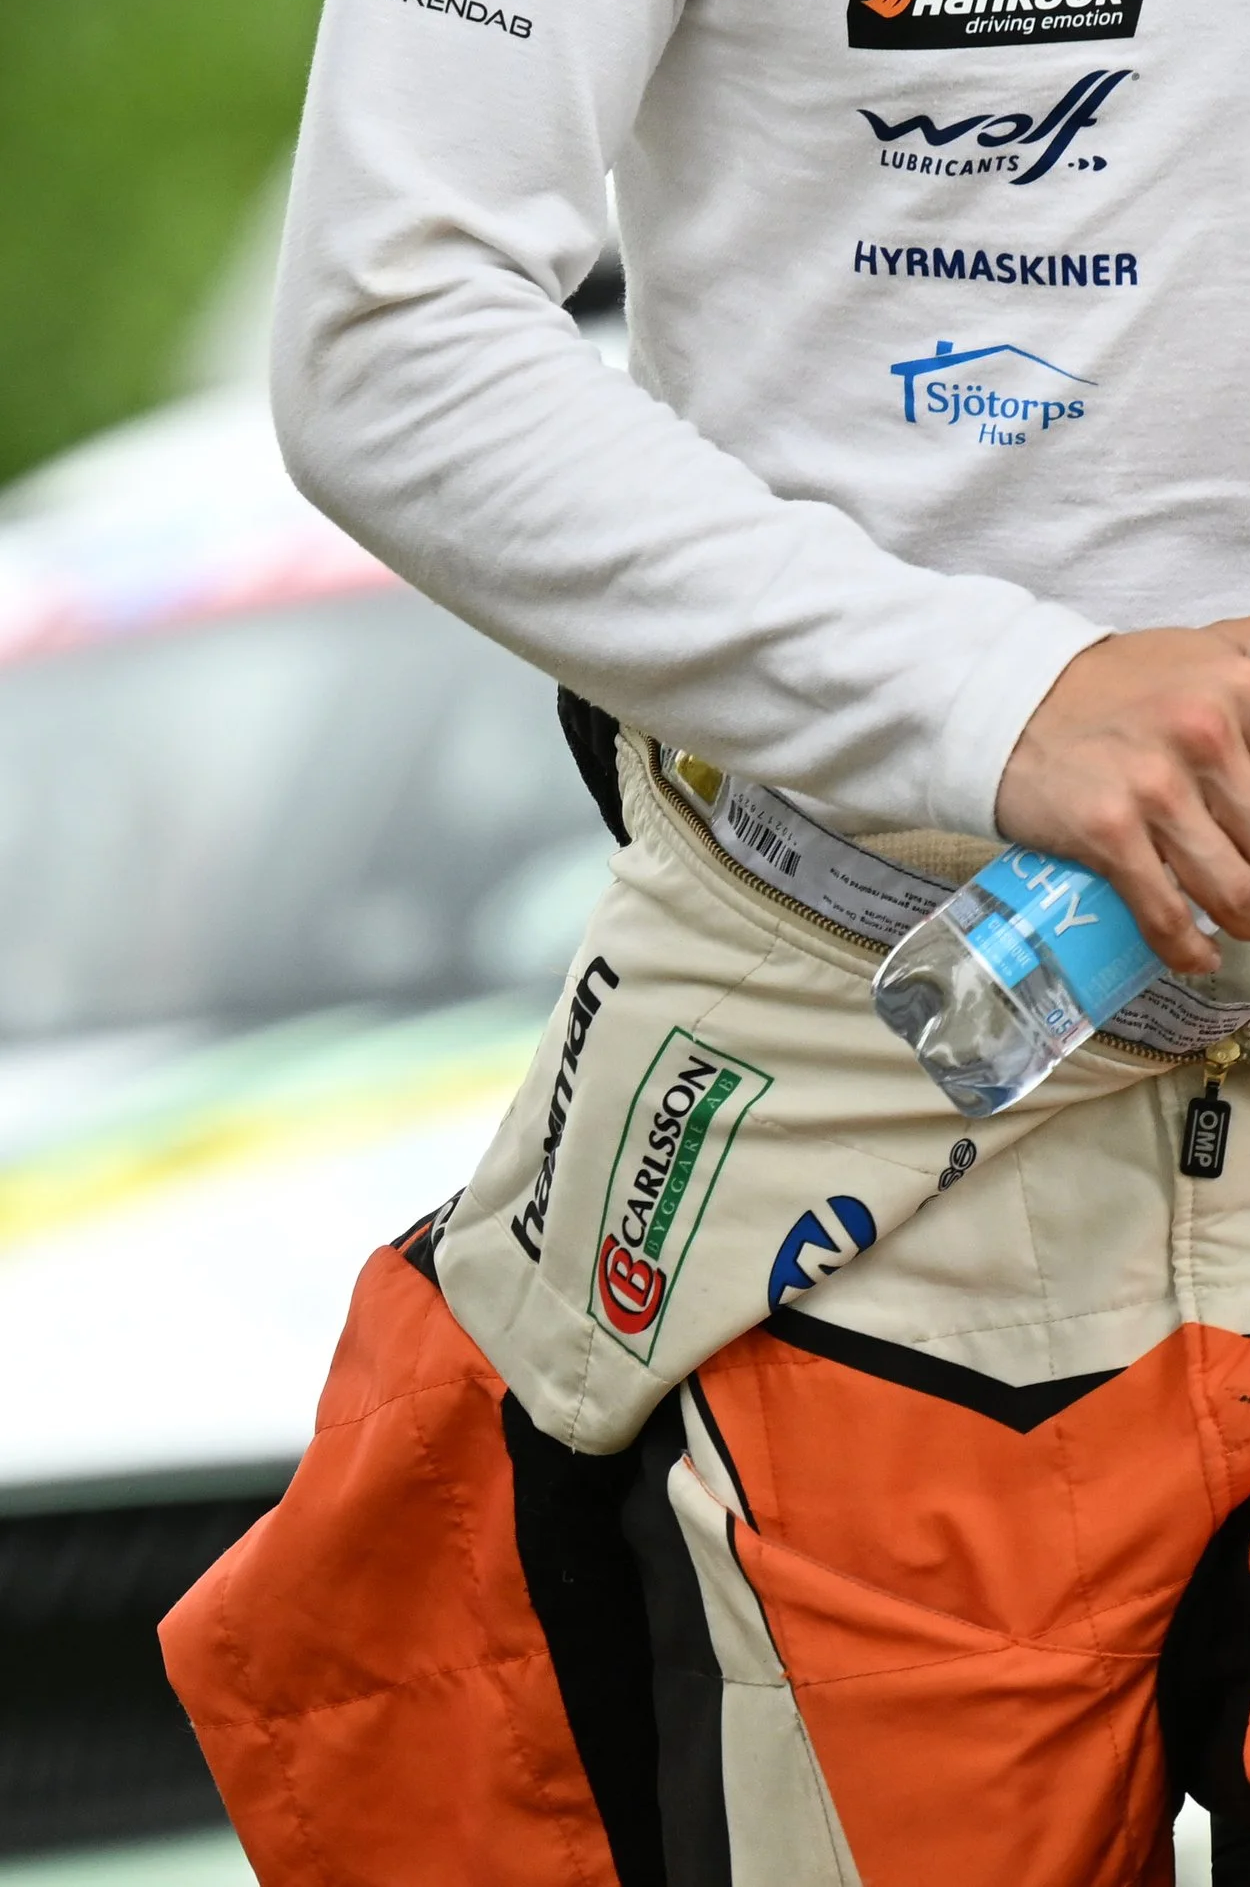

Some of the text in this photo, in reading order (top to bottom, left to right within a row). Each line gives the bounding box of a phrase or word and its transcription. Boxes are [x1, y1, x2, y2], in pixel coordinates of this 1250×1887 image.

[965, 10, 1123, 35] driving emotion
[880, 149, 1020, 176] LUBRICANTS
[854, 240, 1138, 286] HYRMASKINER
[926, 382, 1084, 429] Sjötorps
[978, 424, 1026, 445] Hus
[621, 1055, 718, 1248] CARLSSON
[1194, 1110, 1218, 1168] OMP
[646, 1077, 736, 1254] BYGGARE AB
